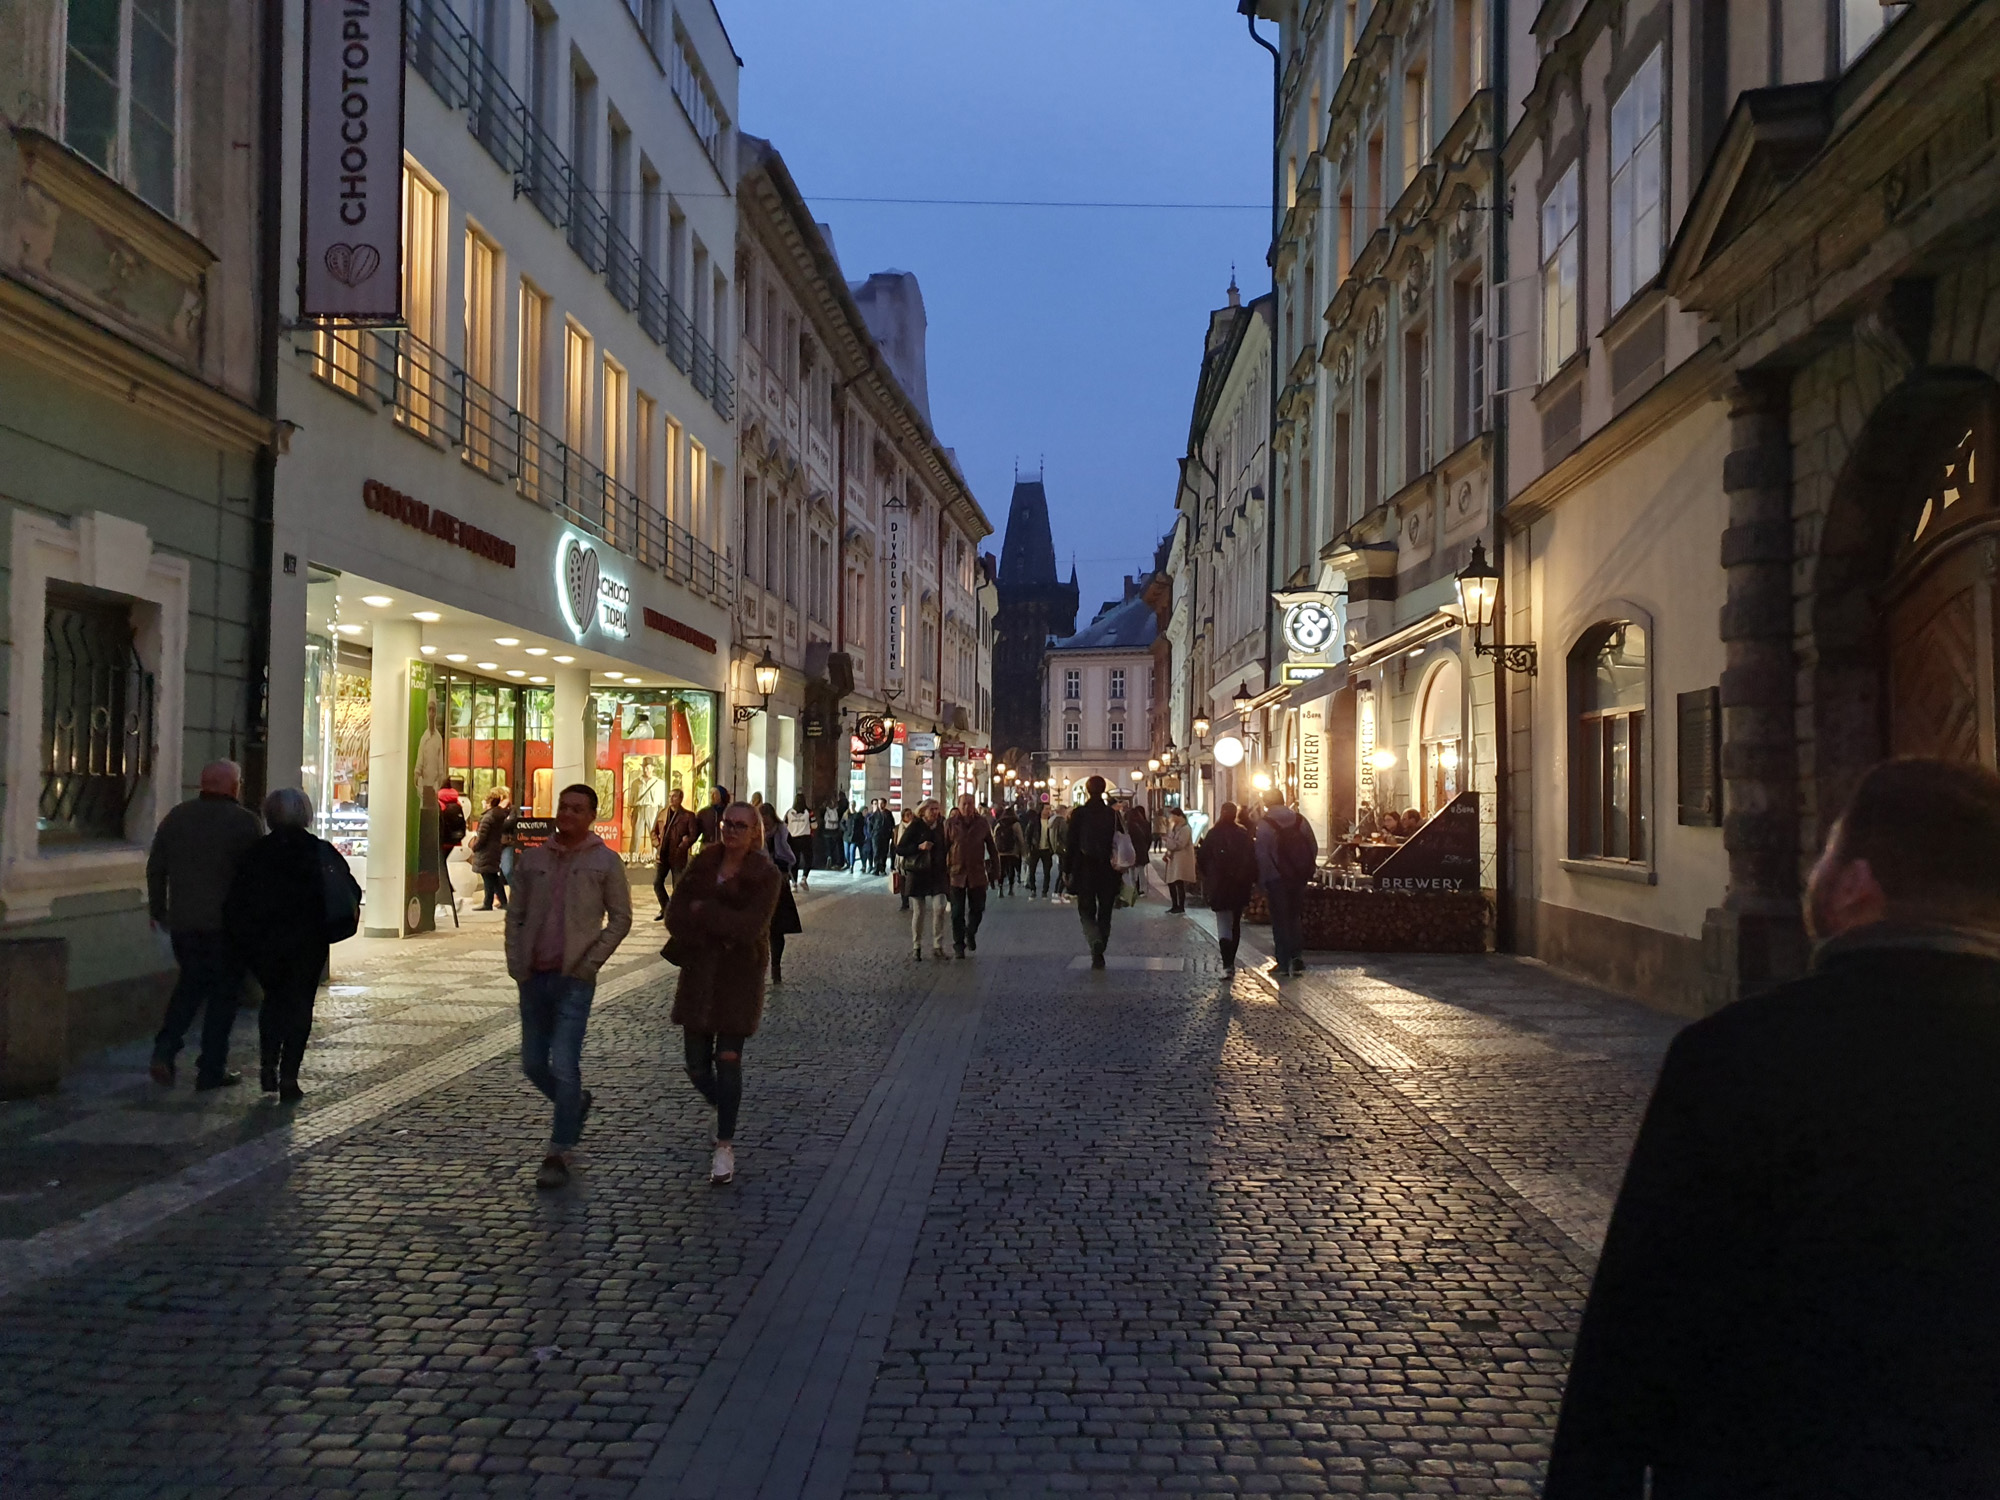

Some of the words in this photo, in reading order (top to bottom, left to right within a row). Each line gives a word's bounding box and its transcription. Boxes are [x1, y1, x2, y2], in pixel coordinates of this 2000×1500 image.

[363, 478, 460, 545] CHOCOLATE
[458, 521, 516, 569] MUSEUM
[890, 522, 898, 589] DIVADLO
[601, 577, 630, 605] CHOCO
[603, 604, 628, 632] TOPIA
[1303, 733, 1319, 789] BREWERY
[1382, 878, 1463, 889] BREWERY
